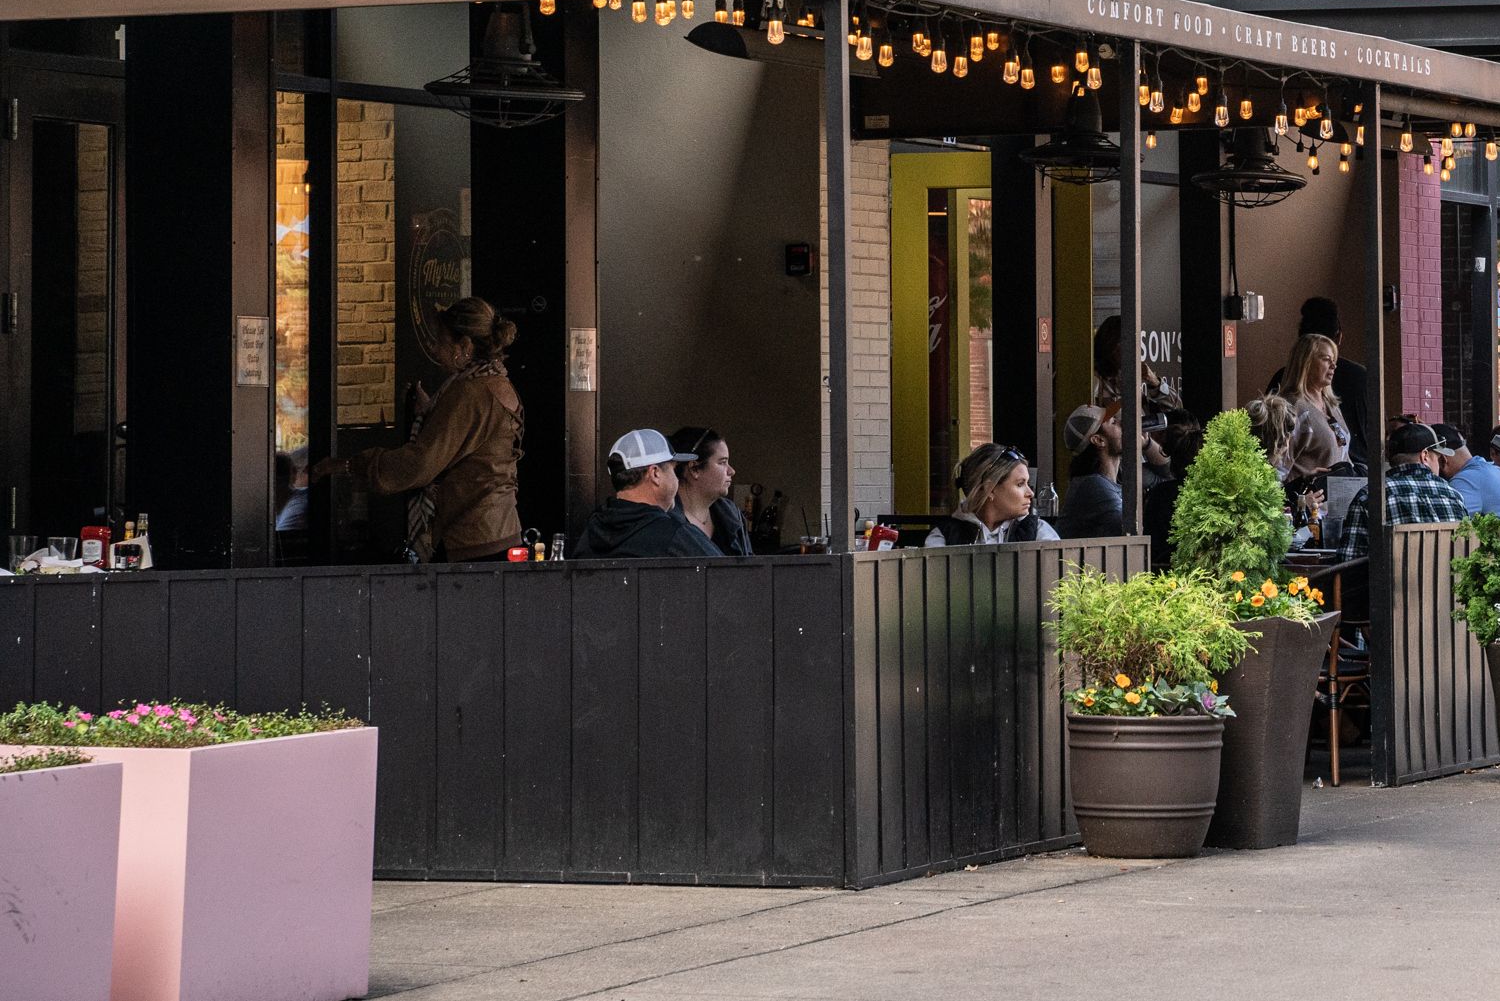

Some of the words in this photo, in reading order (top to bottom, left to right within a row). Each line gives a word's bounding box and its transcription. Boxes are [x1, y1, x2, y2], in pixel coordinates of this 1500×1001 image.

[1174, 12, 1213, 37] FOOD
[1235, 24, 1282, 52] CRAFT
[1292, 38, 1337, 60] BEERS
[1357, 47, 1432, 76] COCKTAILS
